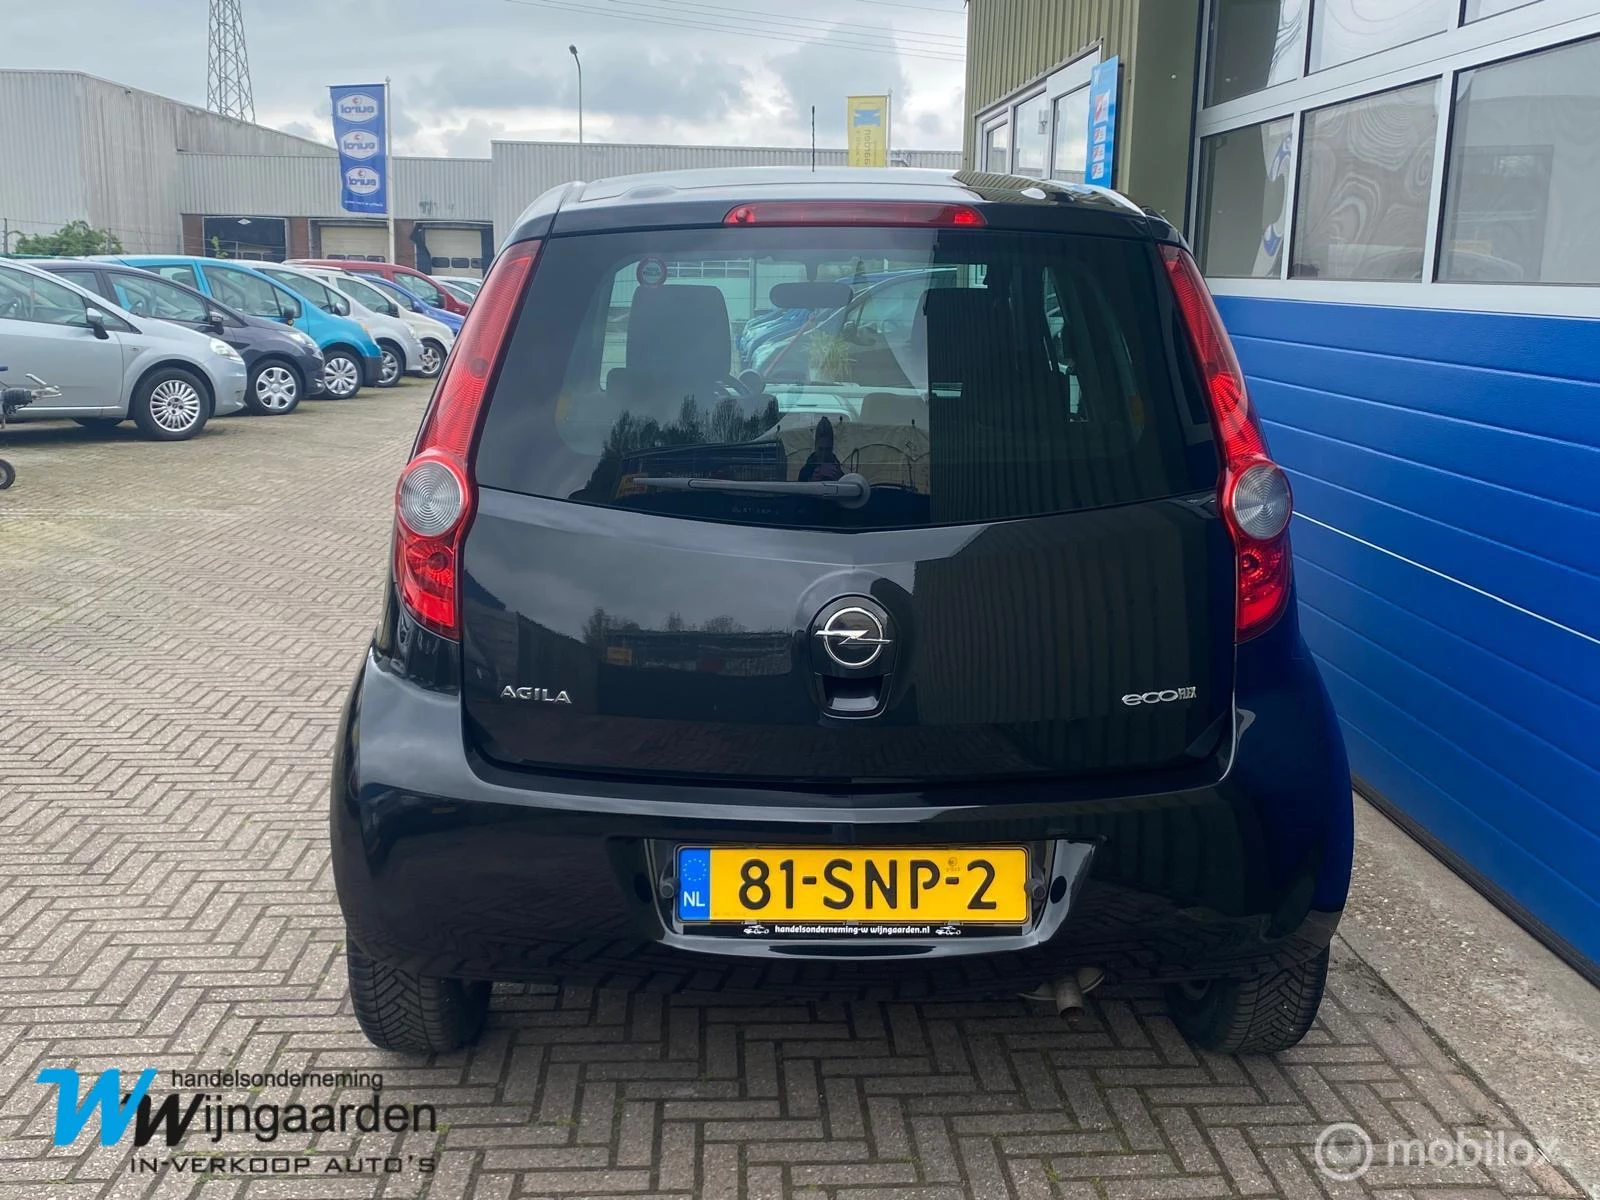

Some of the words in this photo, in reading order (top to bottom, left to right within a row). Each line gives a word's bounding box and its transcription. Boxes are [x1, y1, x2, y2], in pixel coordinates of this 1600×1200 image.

[500, 685, 572, 704] AGILA
[738, 858, 997, 910] 81-SNP-2
[683, 891, 706, 907] NL
[870, 925, 931, 936] wijngaarden.nl
